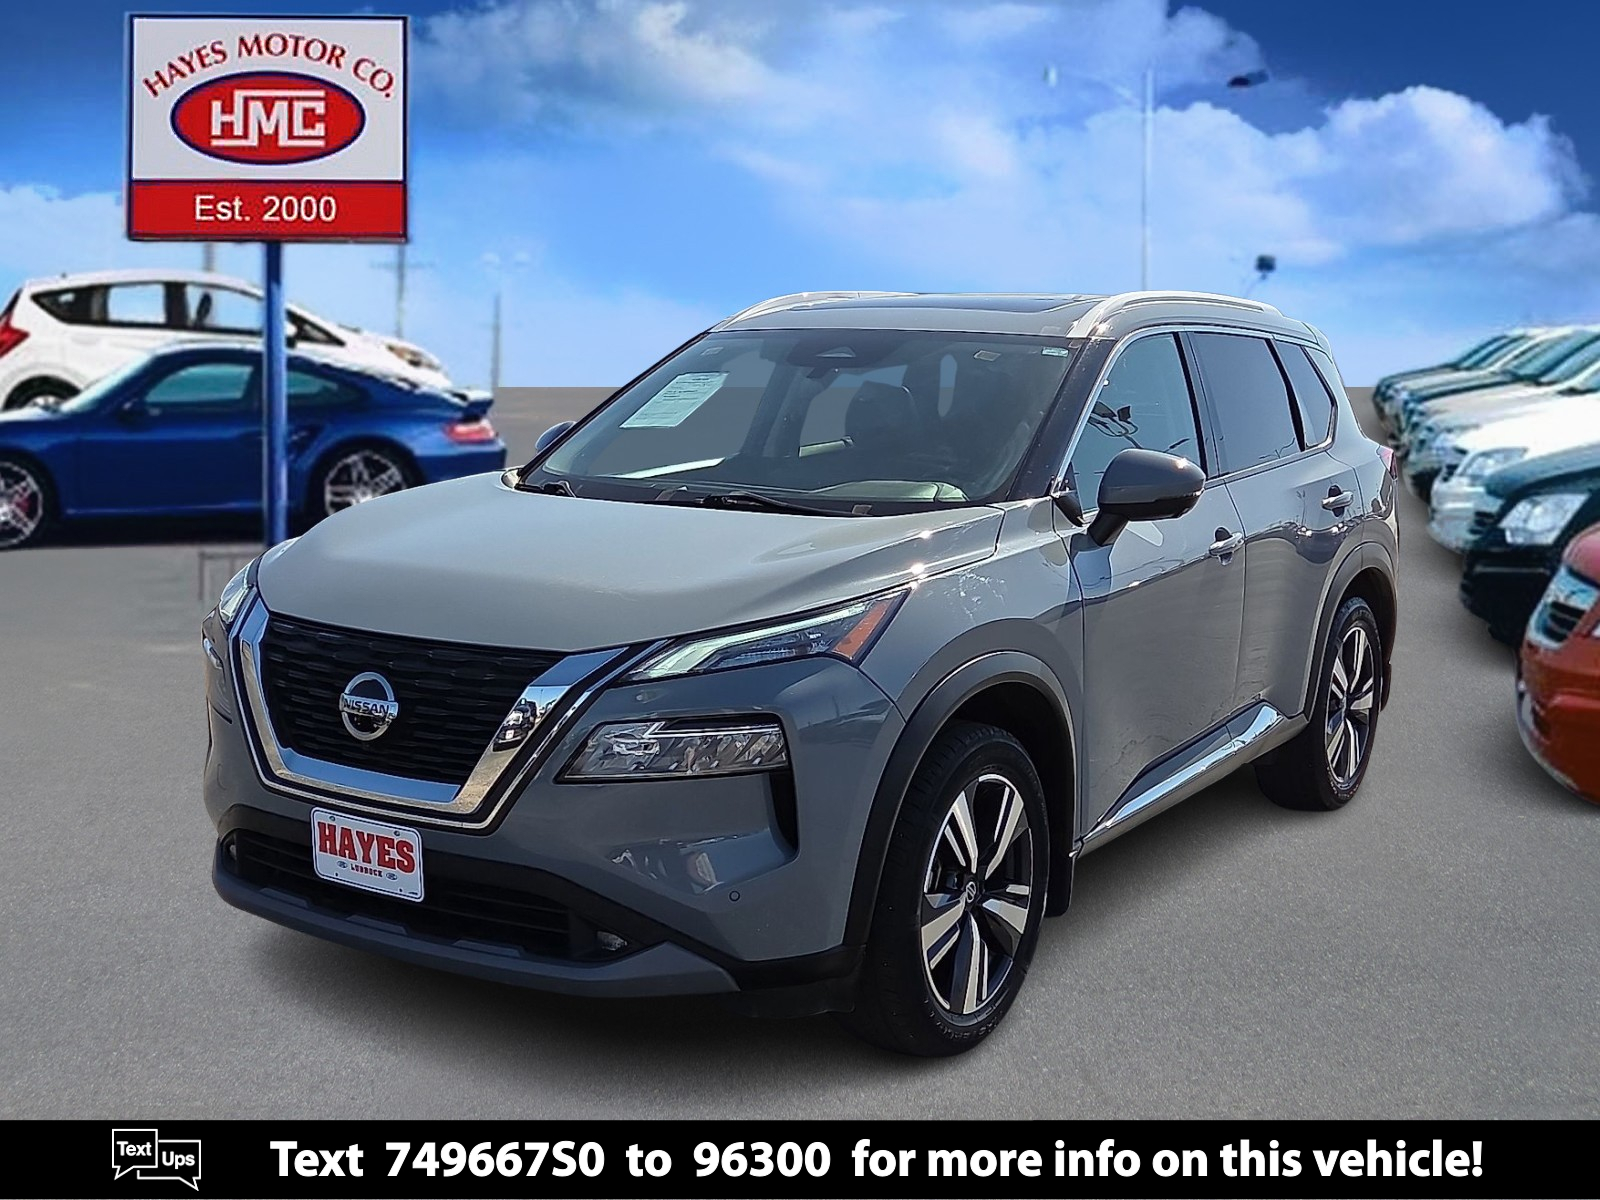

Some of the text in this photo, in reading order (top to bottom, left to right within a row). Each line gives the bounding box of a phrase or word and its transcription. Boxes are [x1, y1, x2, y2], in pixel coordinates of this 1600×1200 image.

[142, 33, 395, 98] HAYES MOTOR CO.
[210, 89, 326, 147] HMC
[194, 194, 337, 222] Est. 2000
[342, 698, 390, 714] NISSAN
[317, 820, 416, 874] HAYES
[350, 863, 383, 878] LUBBOCK
